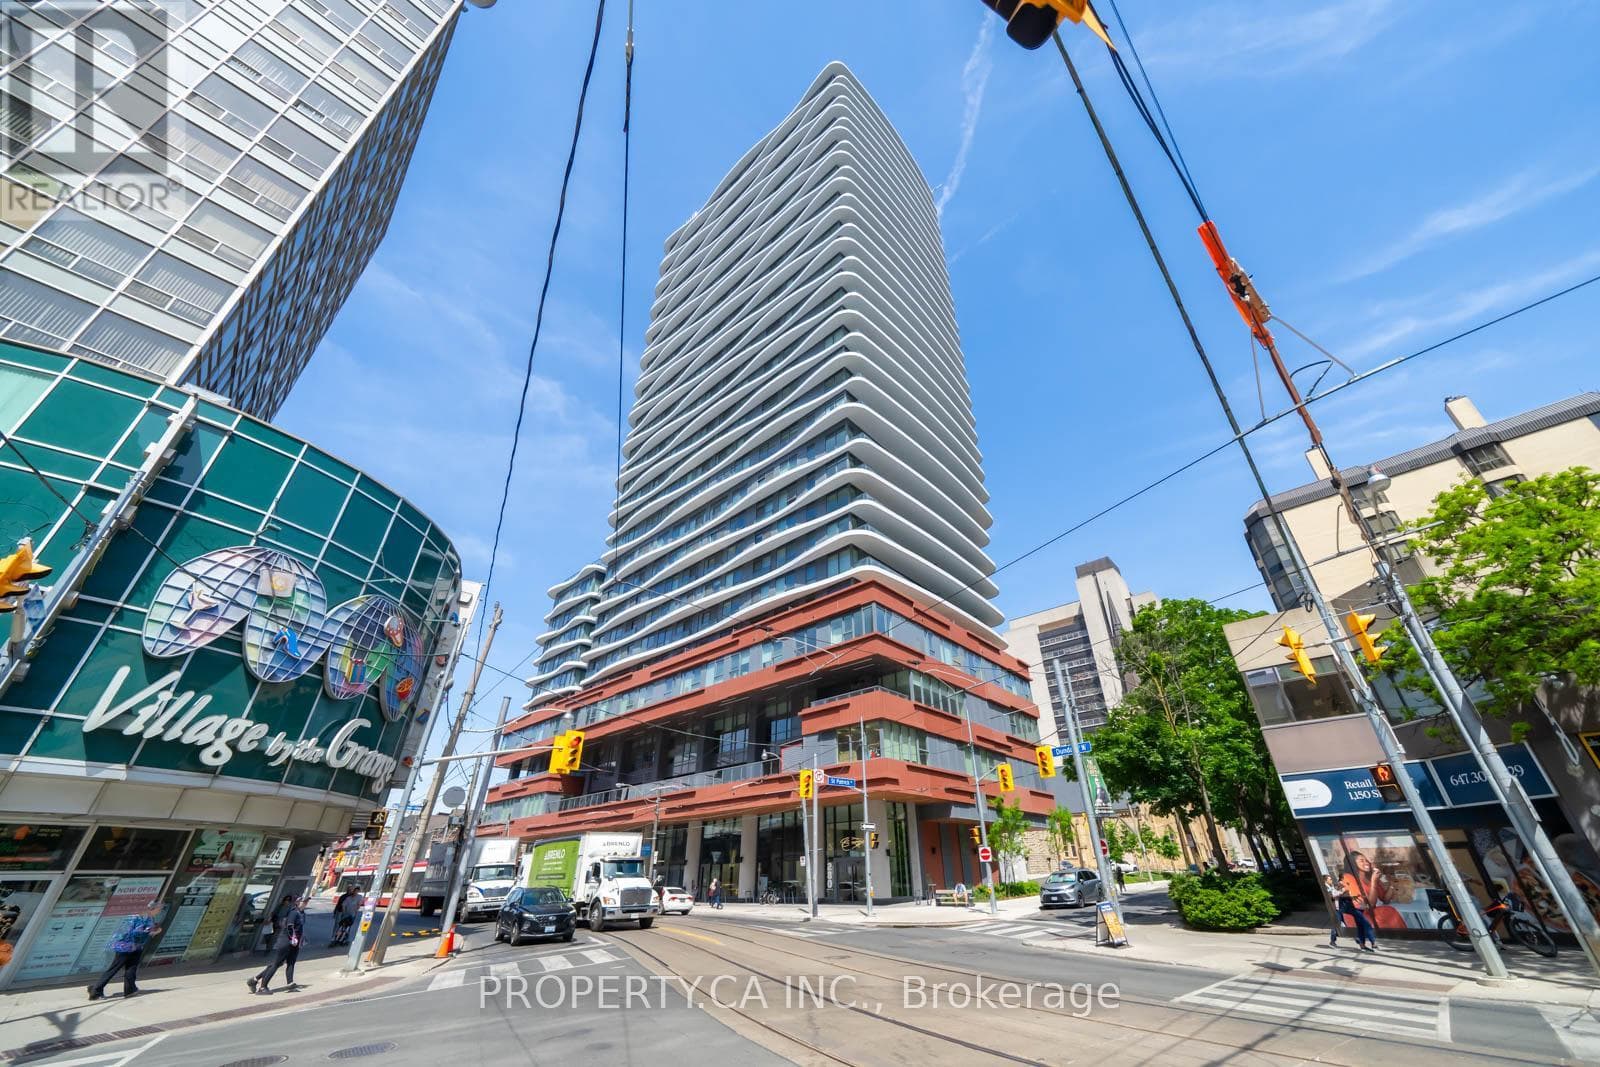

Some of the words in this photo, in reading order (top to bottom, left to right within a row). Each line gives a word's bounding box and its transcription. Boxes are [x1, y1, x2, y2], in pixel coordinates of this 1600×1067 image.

[82, 665, 269, 766] Village
[264, 731, 295, 767] by
[292, 737, 324, 763] the
[325, 718, 398, 794] Grange
[1344, 778, 1373, 790] Retail
